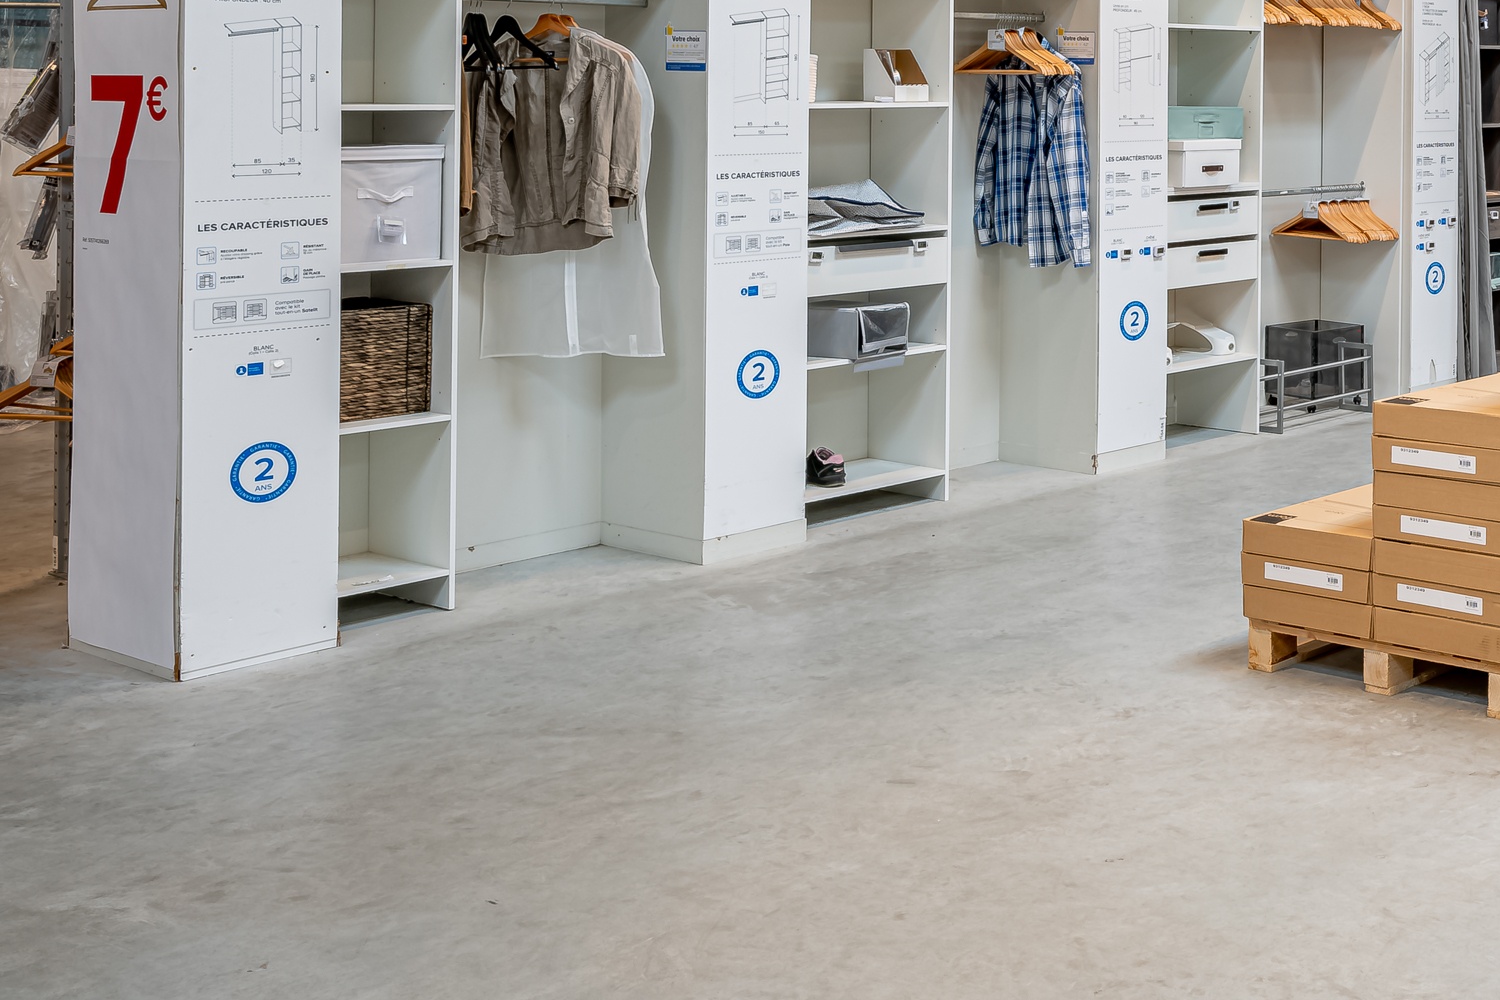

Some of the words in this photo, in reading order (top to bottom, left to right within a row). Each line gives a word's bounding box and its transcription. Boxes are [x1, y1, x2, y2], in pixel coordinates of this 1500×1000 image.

[1115, 153, 1163, 162] CARACTÉRISTIQUES
[716, 172, 729, 180] LES
[731, 169, 801, 180] CARACTÉRISTIQUES
[197, 223, 218, 233] LES
[220, 217, 329, 231] CARACTÉRISTIQUES
[1432, 270, 1439, 283] 2
[1130, 311, 1140, 327] 2
[752, 362, 765, 382] 2
[255, 457, 274, 482] 2
[255, 484, 273, 492] ANS
